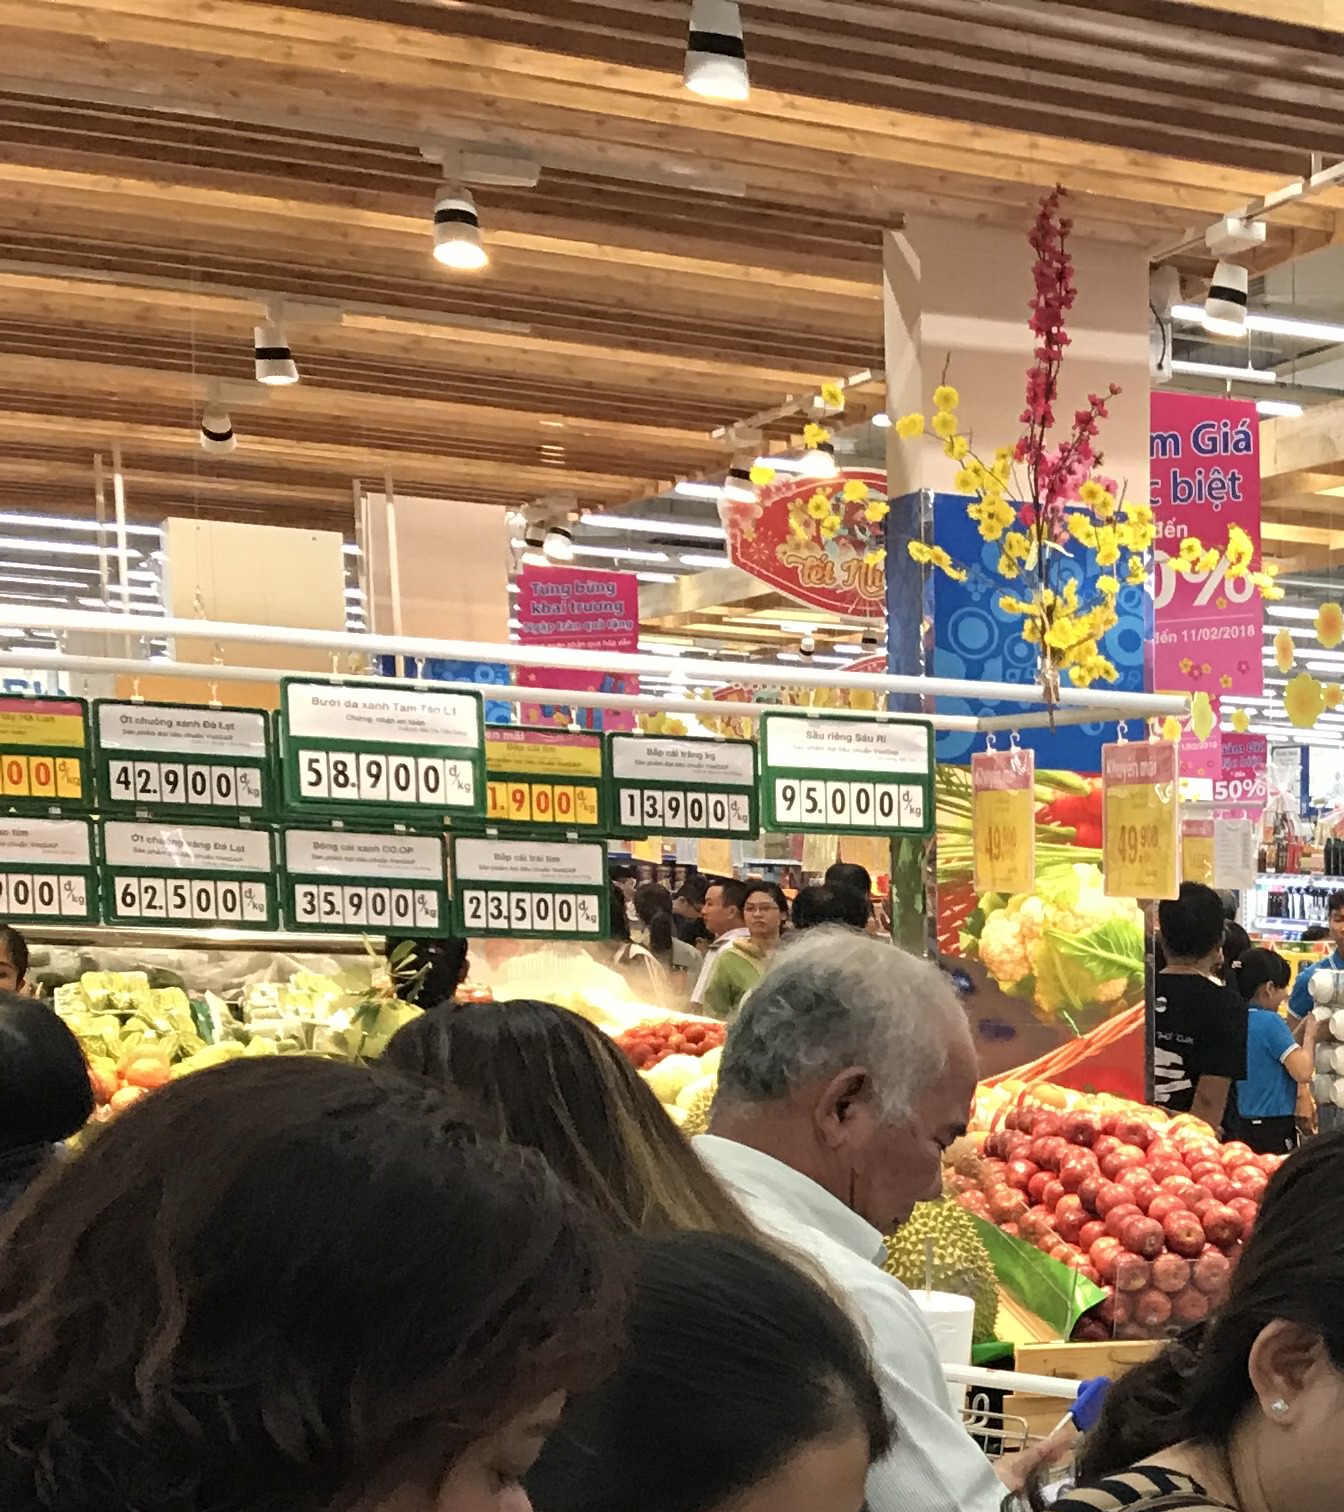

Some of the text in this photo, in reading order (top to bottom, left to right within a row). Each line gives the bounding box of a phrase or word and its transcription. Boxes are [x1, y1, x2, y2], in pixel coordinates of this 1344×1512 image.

[1192, 418, 1253, 455] Giá
[1172, 467, 1242, 511] biệt
[531, 601, 567, 615] khai
[1182, 624, 1256, 643] 11/02/2018
[116, 766, 231, 798] 42.900
[307, 758, 440, 793] 58.900
[1214, 780, 1266, 800] 50%
[627, 794, 726, 822] 13.900
[782, 785, 893, 817] 95.000
[121, 883, 237, 913] 62.500
[302, 891, 408, 917] 35.900
[469, 896, 573, 923] 23.500
